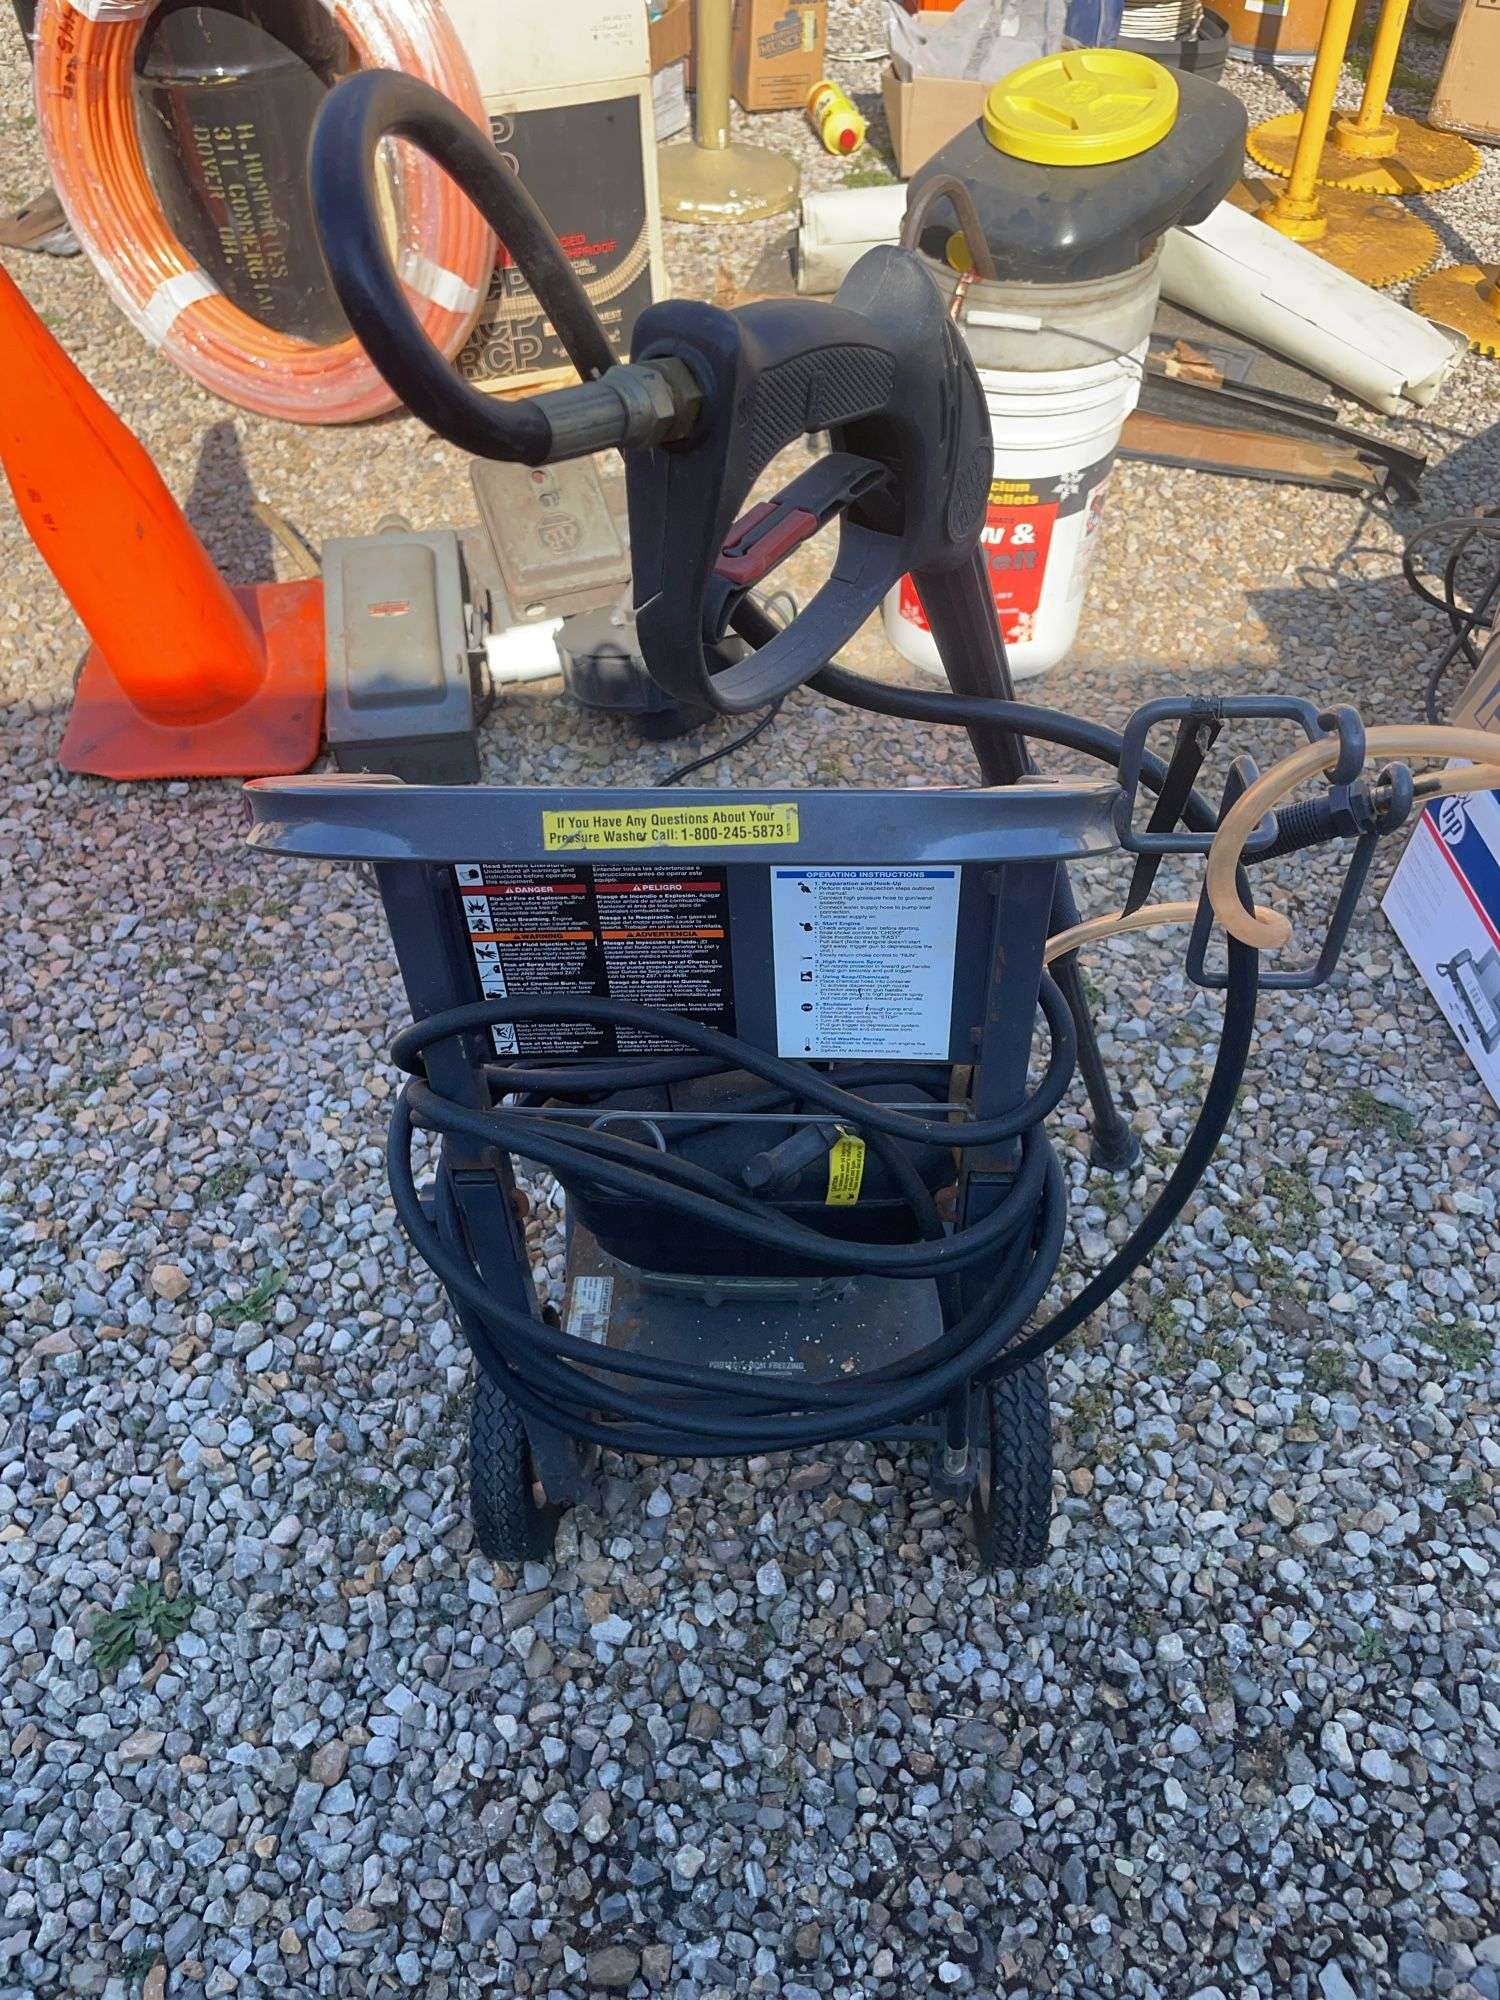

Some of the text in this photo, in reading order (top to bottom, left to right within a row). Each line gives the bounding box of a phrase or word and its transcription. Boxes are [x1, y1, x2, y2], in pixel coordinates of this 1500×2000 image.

[213, 127, 239, 165] 311
[192, 124, 226, 199] DOVER
[459, 337, 543, 379] RCP
[991, 481, 1031, 492] cium
[984, 549, 1037, 571] elt
[557, 818, 565, 829] If
[569, 816, 590, 828] You
[593, 815, 622, 827] Have
[626, 814, 647, 829] Any
[651, 812, 709, 827] Questions
[712, 810, 745, 823] About
[749, 809, 775, 822] Your
[549, 823, 785, 844] Presure Washer Call: 1-800-245-5873
